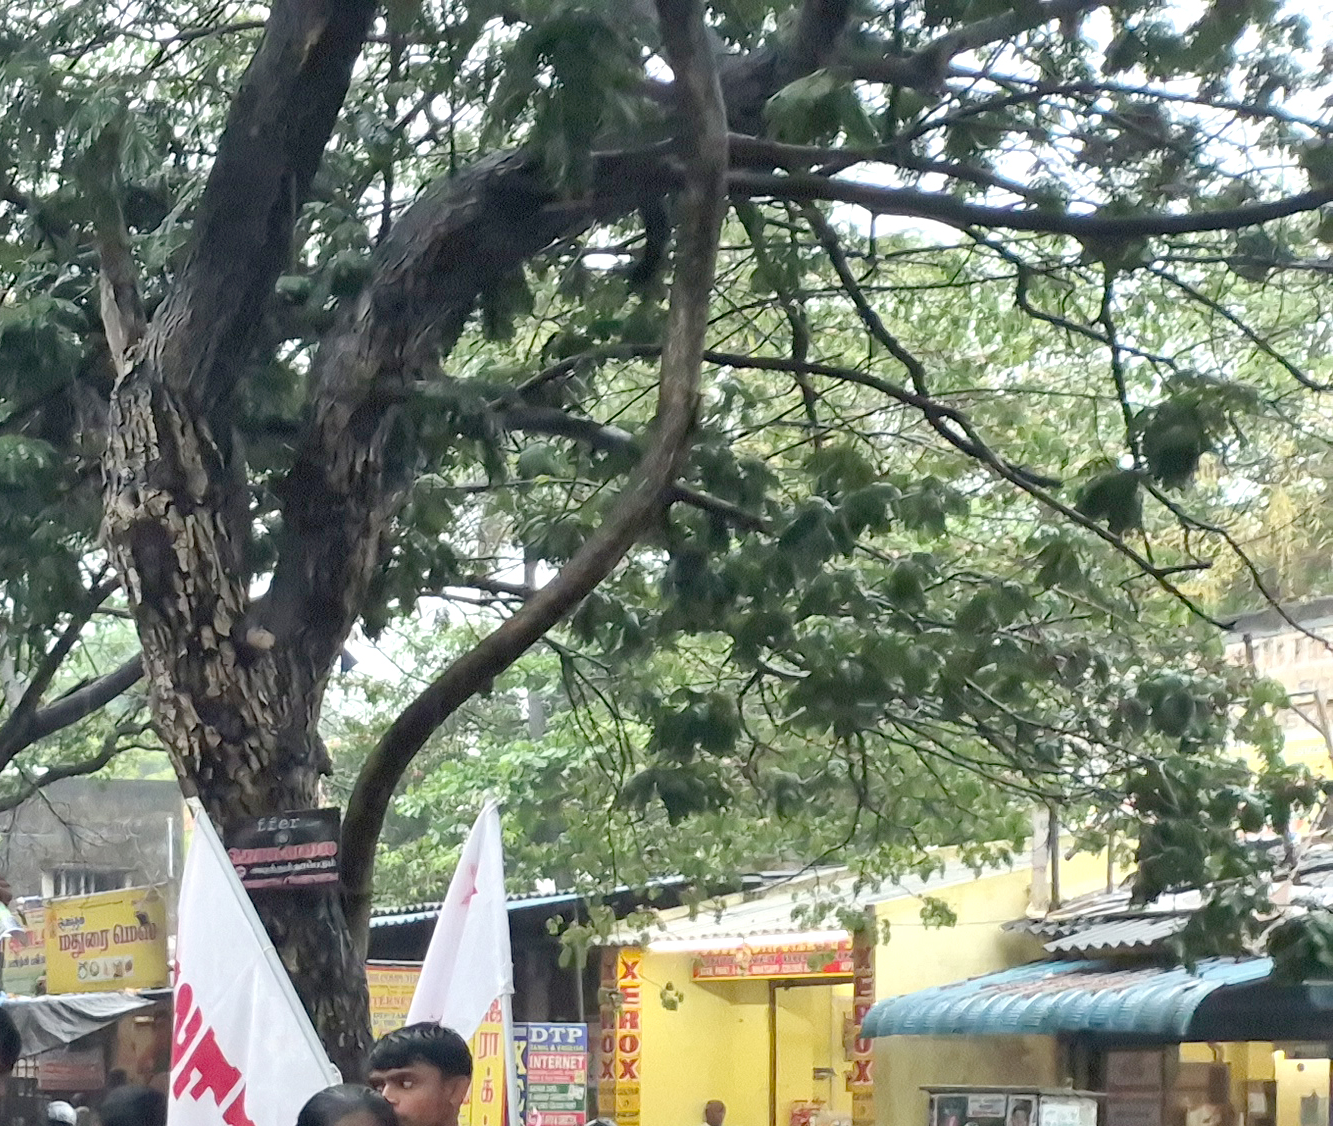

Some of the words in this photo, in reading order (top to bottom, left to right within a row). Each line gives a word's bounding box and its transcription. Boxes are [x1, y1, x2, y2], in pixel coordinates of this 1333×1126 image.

[618, 960, 641, 1081] XEROX
[530, 1027, 583, 1044] DTP
[529, 1056, 584, 1070] INTERNET
